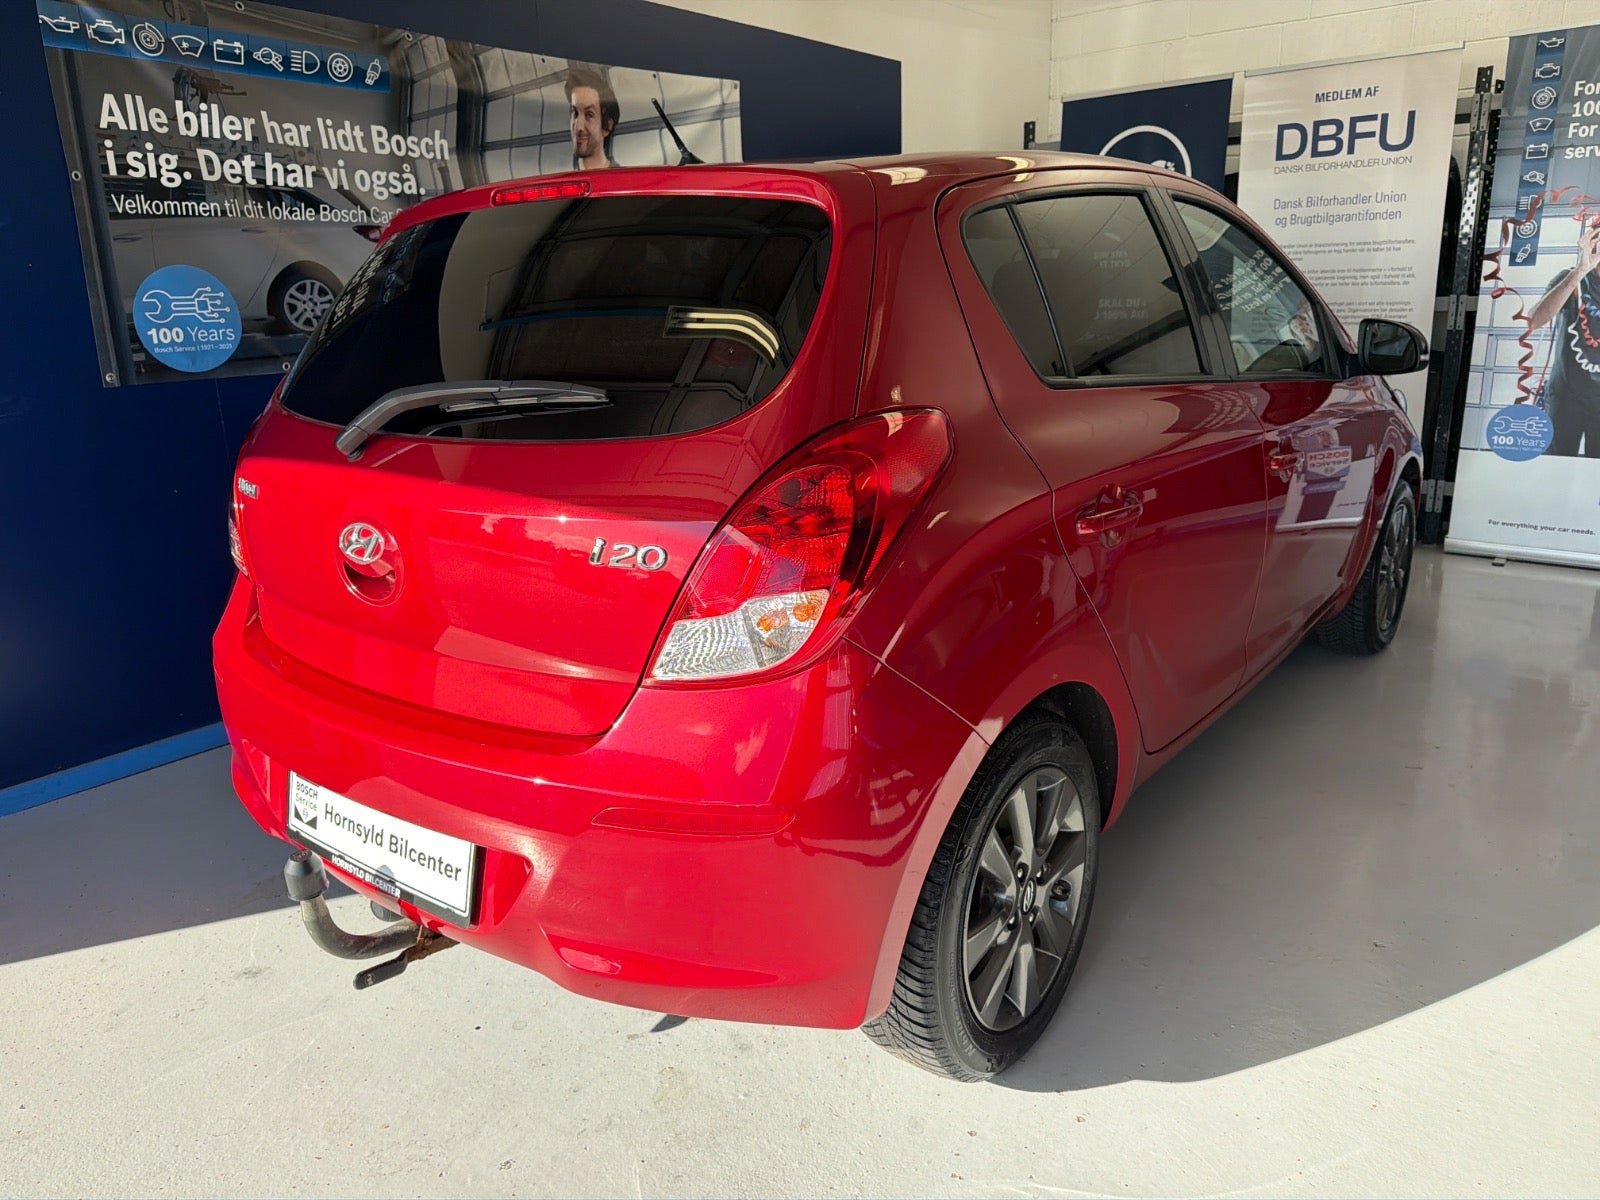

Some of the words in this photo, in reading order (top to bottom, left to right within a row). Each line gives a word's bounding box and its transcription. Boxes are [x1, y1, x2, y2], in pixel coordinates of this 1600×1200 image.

[1315, 88, 1362, 103] MEDLEM
[1365, 86, 1380, 98] AF
[99, 93, 169, 134] Alle
[175, 100, 256, 142] biler
[260, 110, 311, 148] har
[316, 117, 368, 153] lidt
[370, 124, 450, 161] Bosch
[1275, 110, 1416, 162] DBFU
[1568, 122, 1599, 138] For
[104, 139, 118, 176] i
[126, 142, 192, 188] sig.
[196, 148, 257, 186] Det
[264, 152, 316, 189] har
[322, 159, 350, 191] vi
[354, 163, 426, 201] også.
[1274, 165, 1304, 175] DANSK
[1305, 158, 1380, 172] BILFORHANDLER
[1381, 156, 1413, 167] UNION
[111, 193, 221, 217] Velkommen
[224, 199, 241, 218] til
[243, 200, 266, 219] dit
[267, 201, 315, 221] lokale
[320, 204, 367, 224] Bosch
[370, 206, 394, 224] Car
[1273, 197, 1303, 210] Dansk
[1306, 193, 1372, 209] Bilforhandler
[1375, 191, 1407, 203] Union
[1275, 216, 1287, 228] og
[1290, 208, 1402, 227] Brugtbilgarantifonden
[147, 327, 185, 344] 100
[186, 326, 235, 342] Years
[1492, 435, 1514, 445] 100
[1516, 437, 1546, 448] Years
[1501, 520, 1538, 530] everything
[1571, 527, 1596, 535] needs.
[589, 537, 669, 571] i20
[296, 781, 318, 800] BOSCH
[295, 793, 318, 811] Service
[324, 802, 385, 848] Hornsyld
[389, 833, 462, 881] Bilcenter
[331, 854, 364, 880] HORNSYLD
[365, 871, 401, 898] BILCENTER
